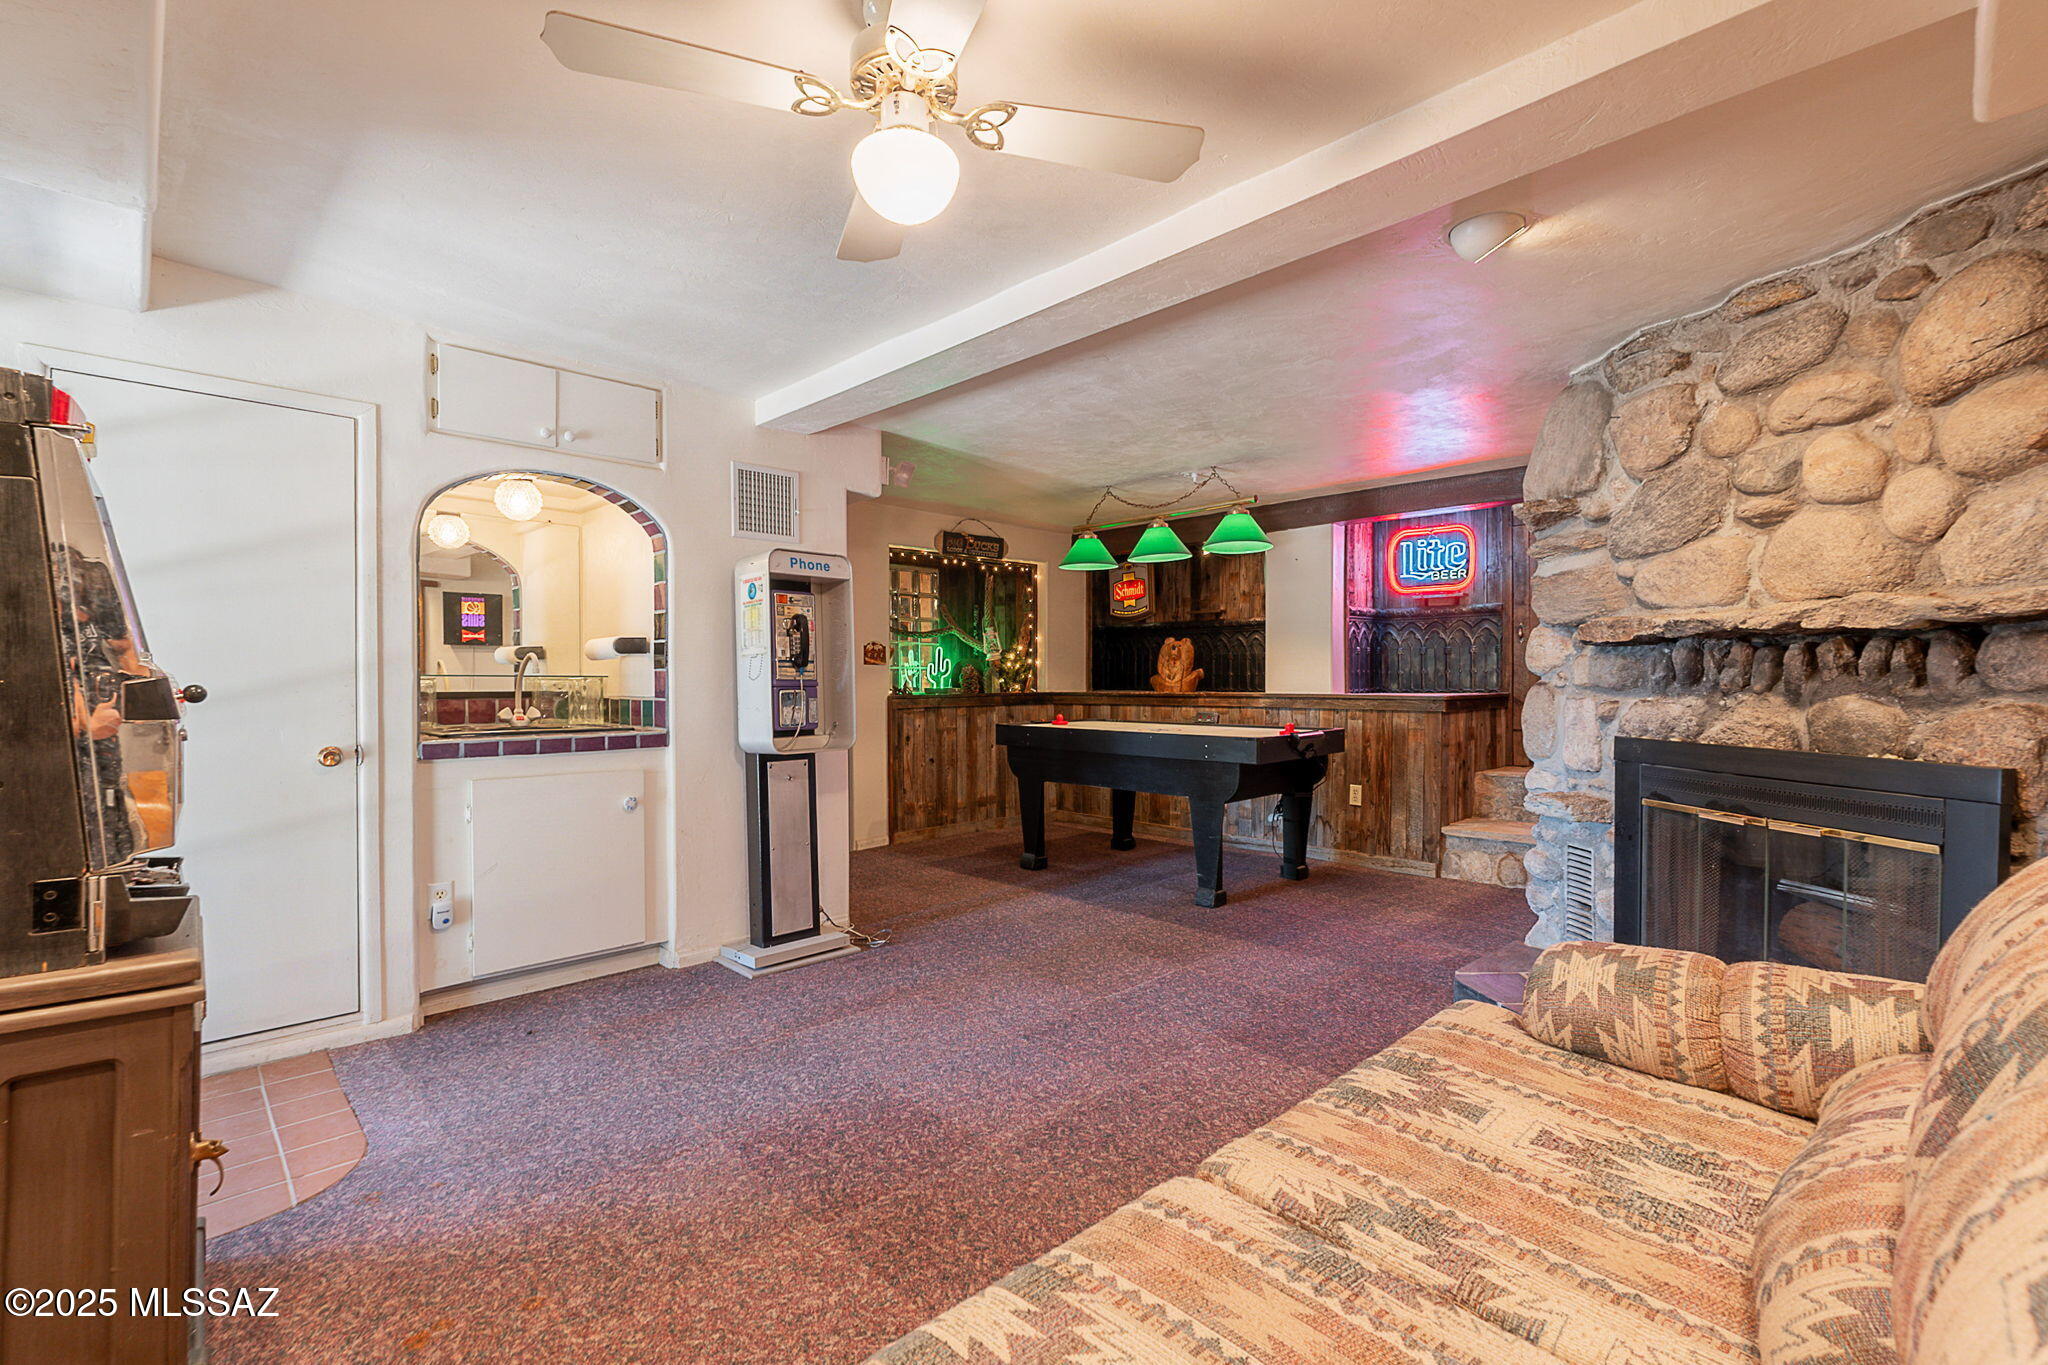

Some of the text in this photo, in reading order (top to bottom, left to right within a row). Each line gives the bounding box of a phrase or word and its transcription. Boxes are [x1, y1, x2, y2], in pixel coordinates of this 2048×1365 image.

[789, 557, 831, 572] Phone
[1400, 538, 1467, 580] Lite
[1430, 569, 1468, 582] BEER
[1115, 581, 1145, 600] Schmidt
